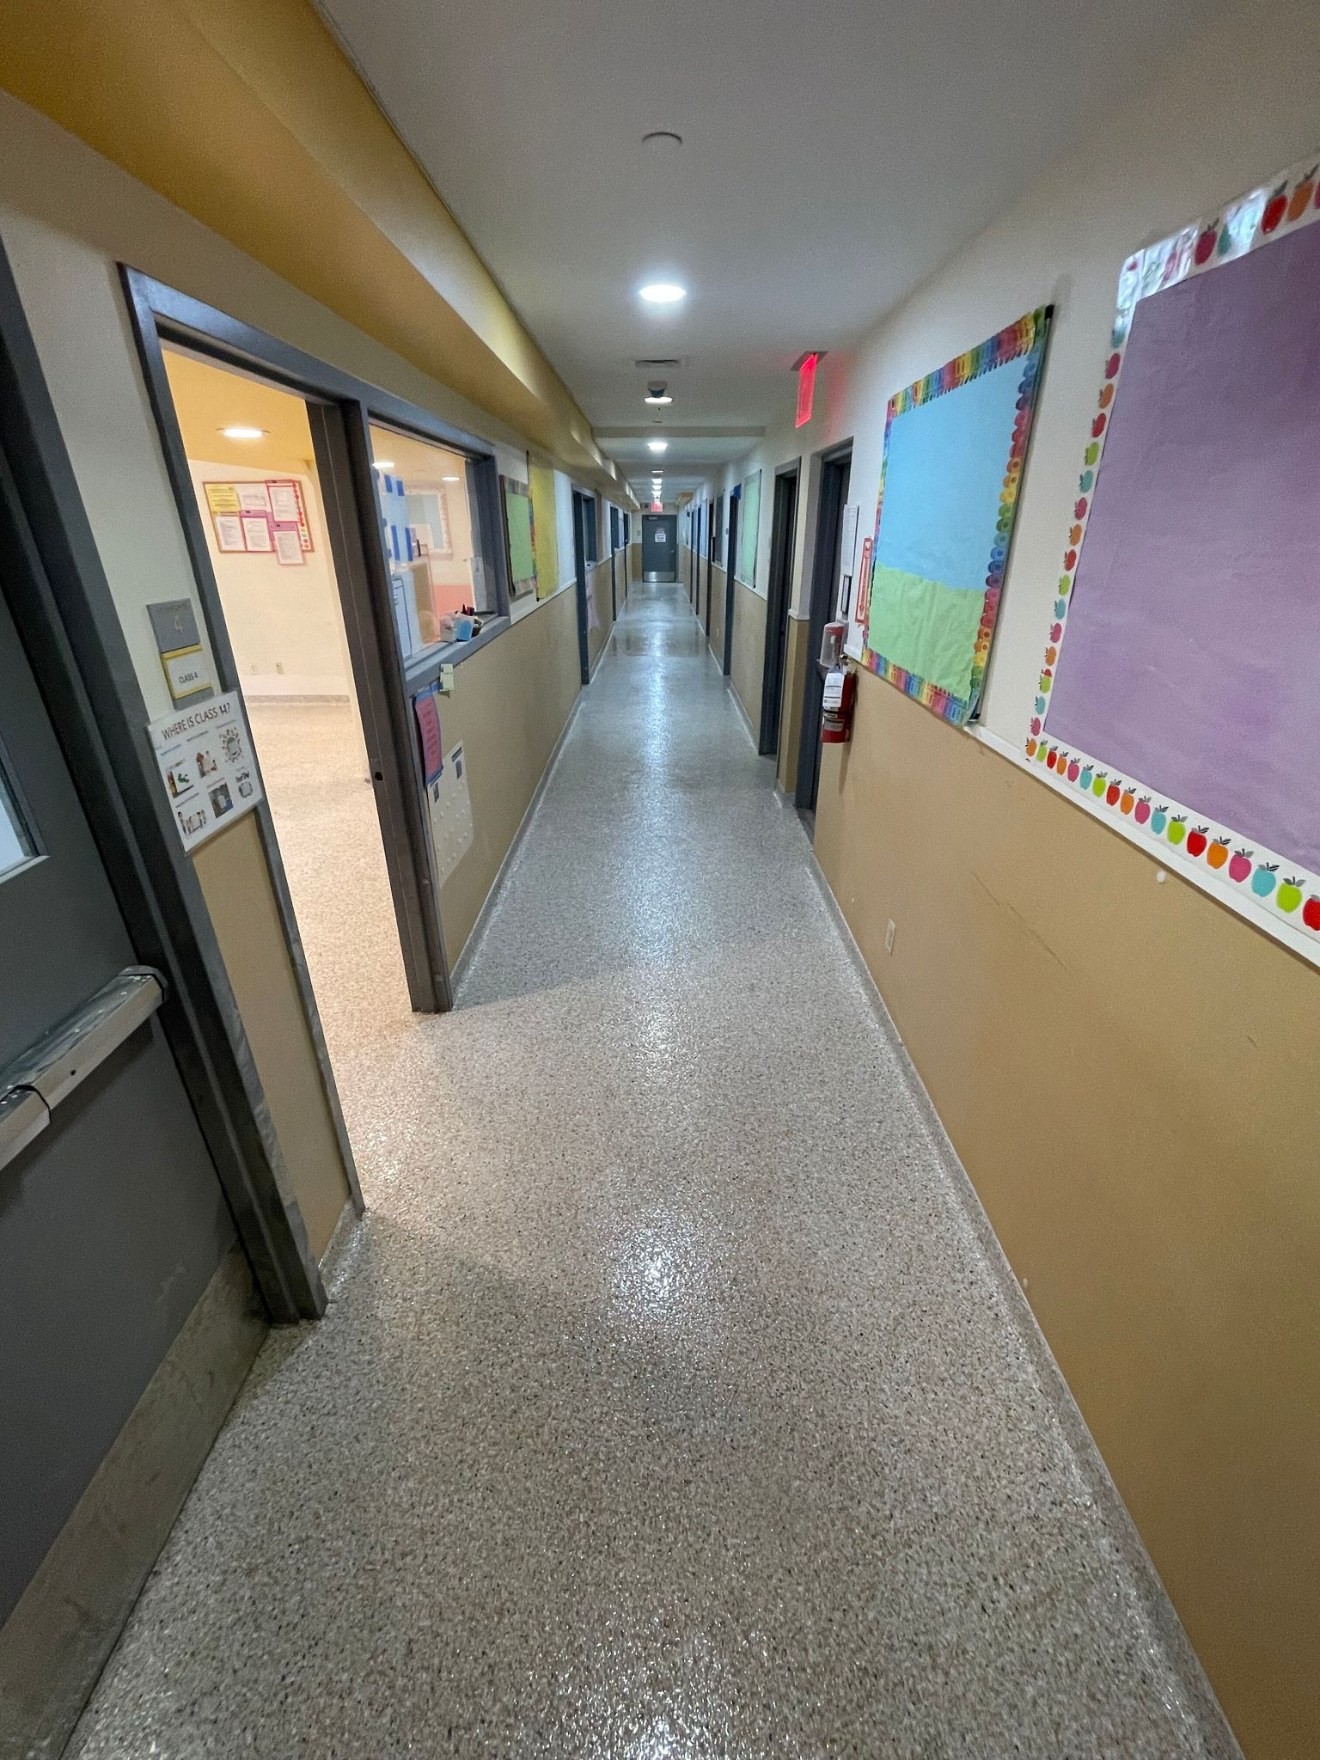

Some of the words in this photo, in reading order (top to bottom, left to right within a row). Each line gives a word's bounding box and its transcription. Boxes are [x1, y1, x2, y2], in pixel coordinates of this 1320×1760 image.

[178, 672, 195, 684] CLASS
[161, 719, 187, 740] WHERE
[187, 716, 195, 728] IS
[194, 707, 218, 725] CLASS
